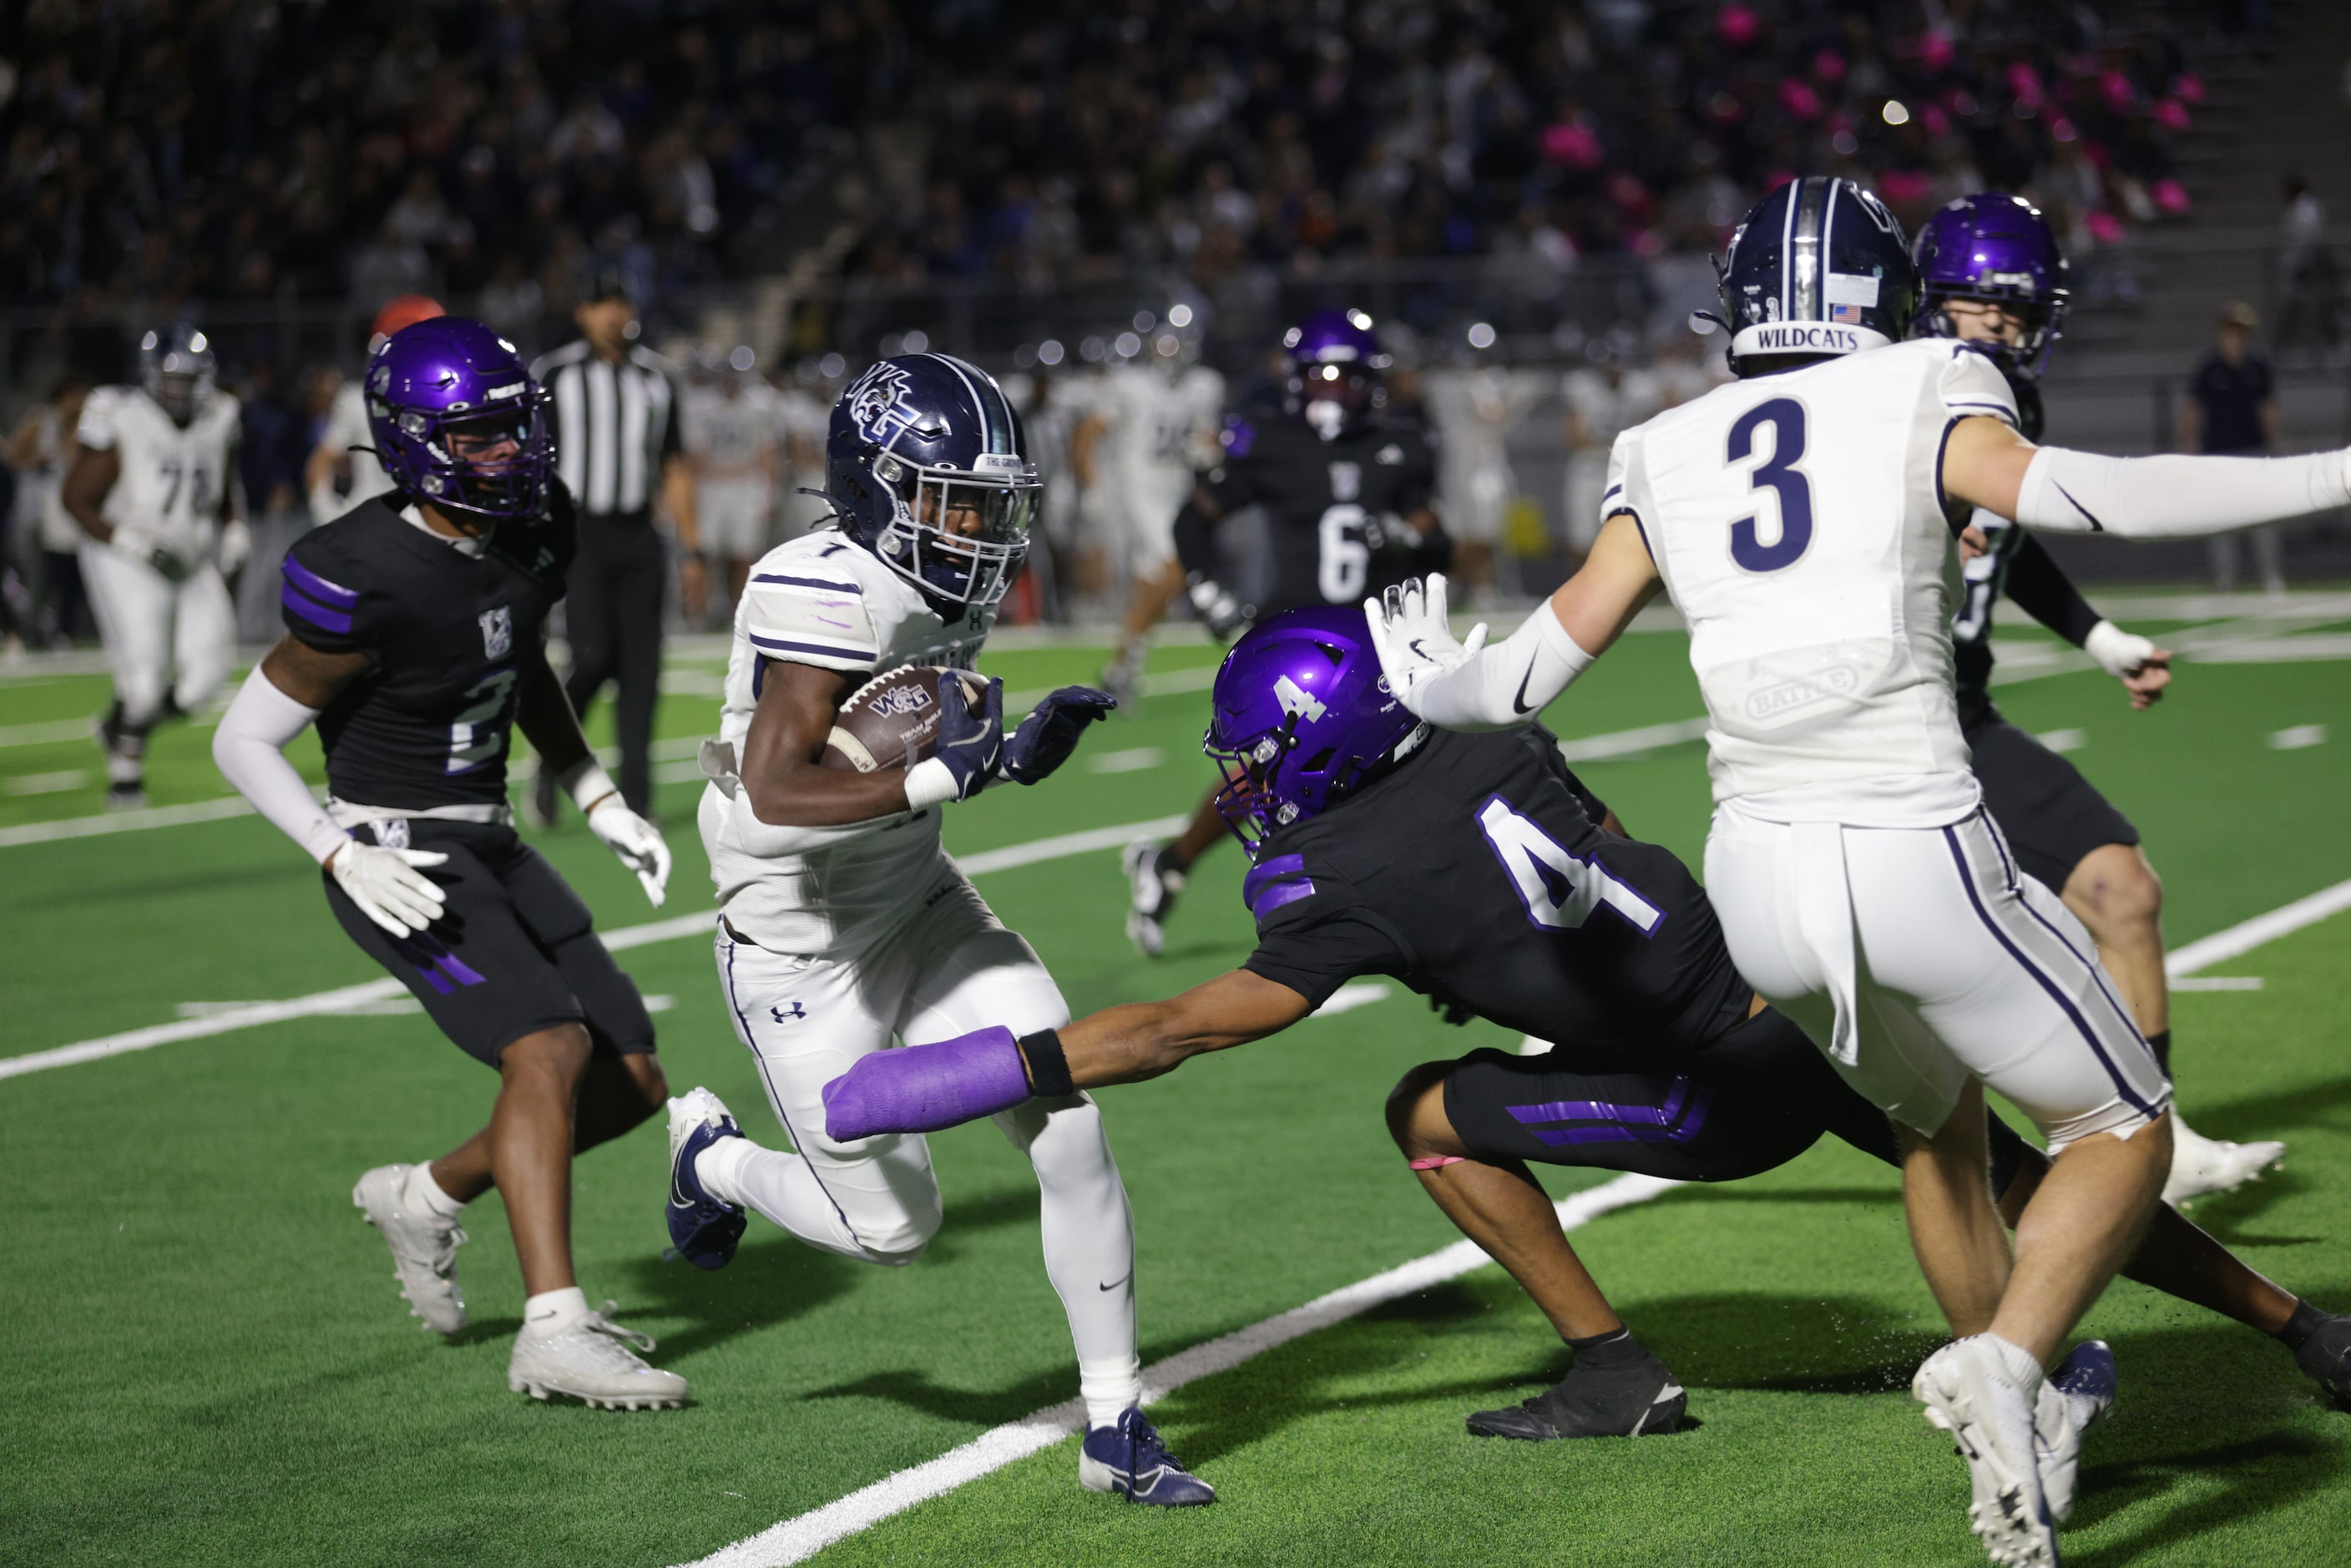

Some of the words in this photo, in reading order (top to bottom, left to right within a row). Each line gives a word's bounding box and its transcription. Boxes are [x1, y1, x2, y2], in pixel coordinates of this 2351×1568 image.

[1758, 328, 1858, 350] WILDCATS
[1722, 392, 1818, 578] 3
[1318, 503, 1369, 604] 6
[443, 665, 518, 776] 2
[1272, 675, 1327, 724] 4
[1474, 792, 1669, 940] 4
